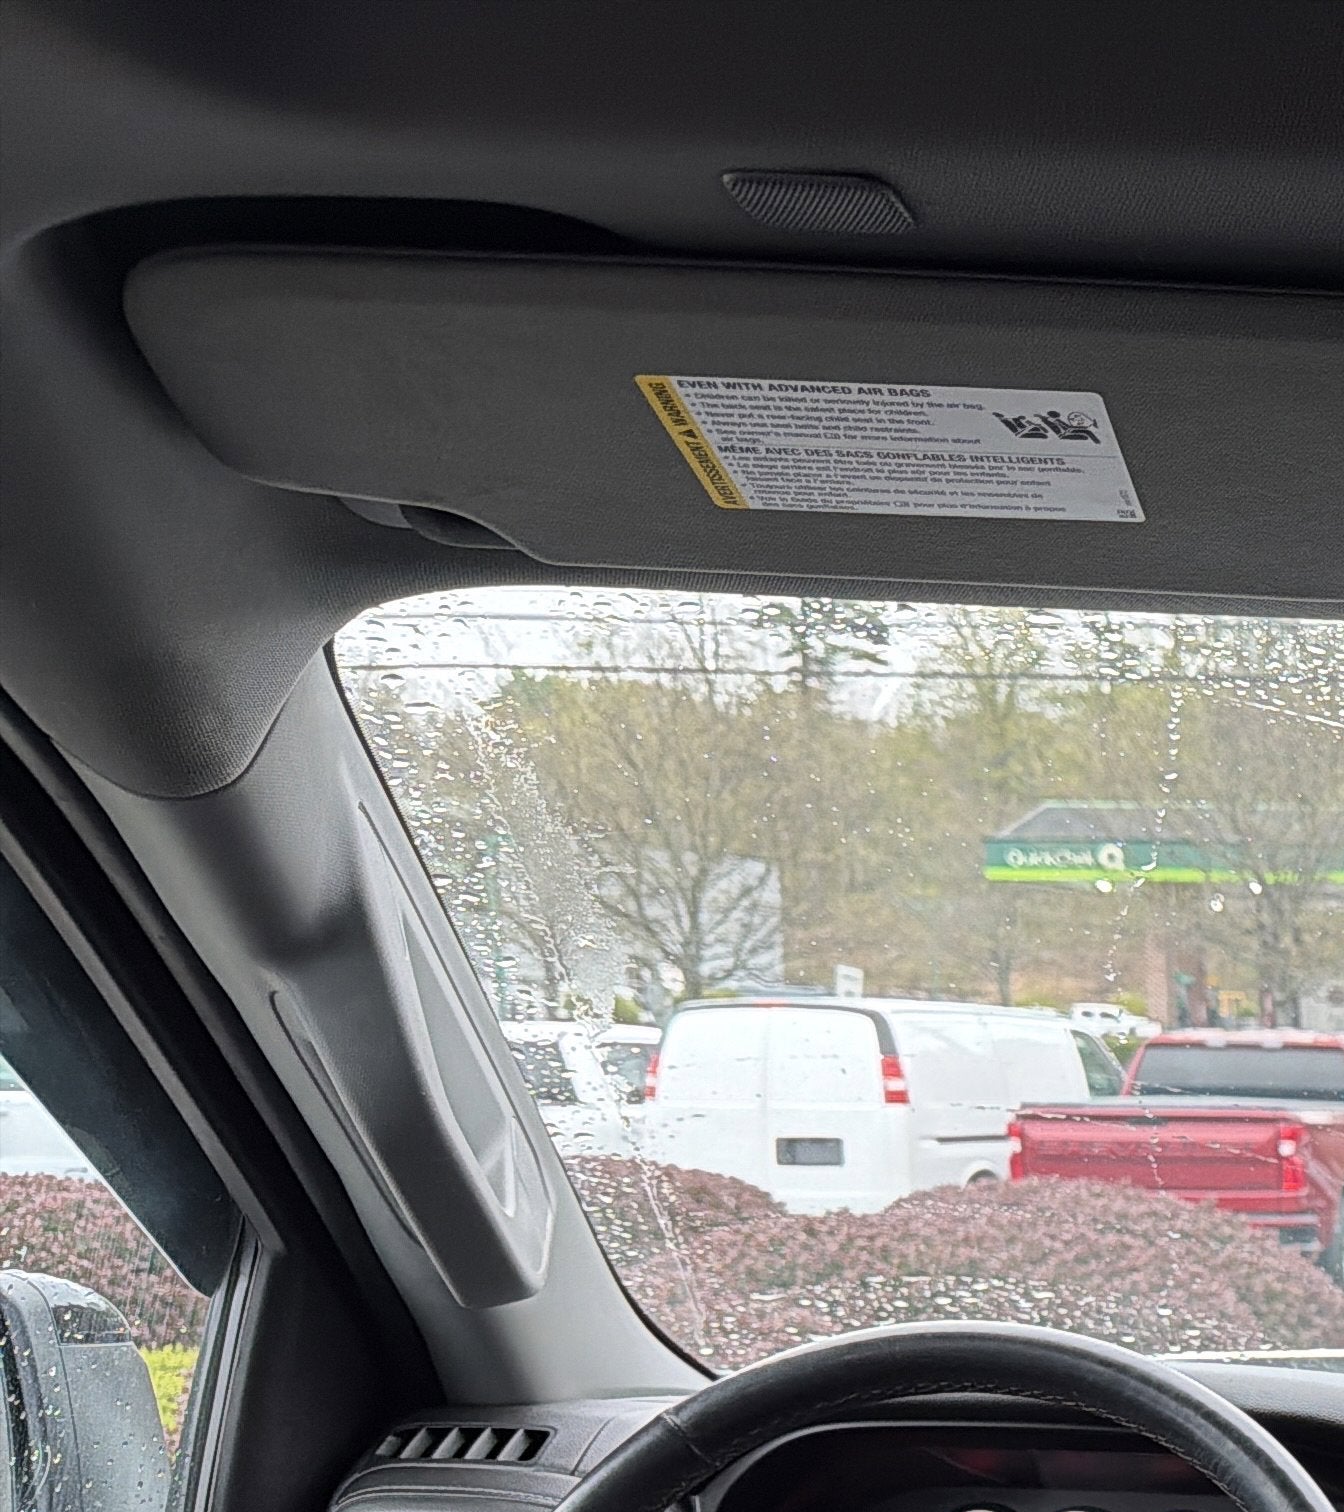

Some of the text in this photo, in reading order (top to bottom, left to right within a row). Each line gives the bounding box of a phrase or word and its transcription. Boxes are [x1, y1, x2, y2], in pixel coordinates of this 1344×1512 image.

[677, 379, 932, 398] EVEN WITH ADVANCED AIR BAGS
[765, 447, 800, 456] AVEC
[835, 450, 873, 458] SACS
[876, 452, 967, 462] GONFLABLES
[969, 455, 1066, 465] INTELLIGENTS
